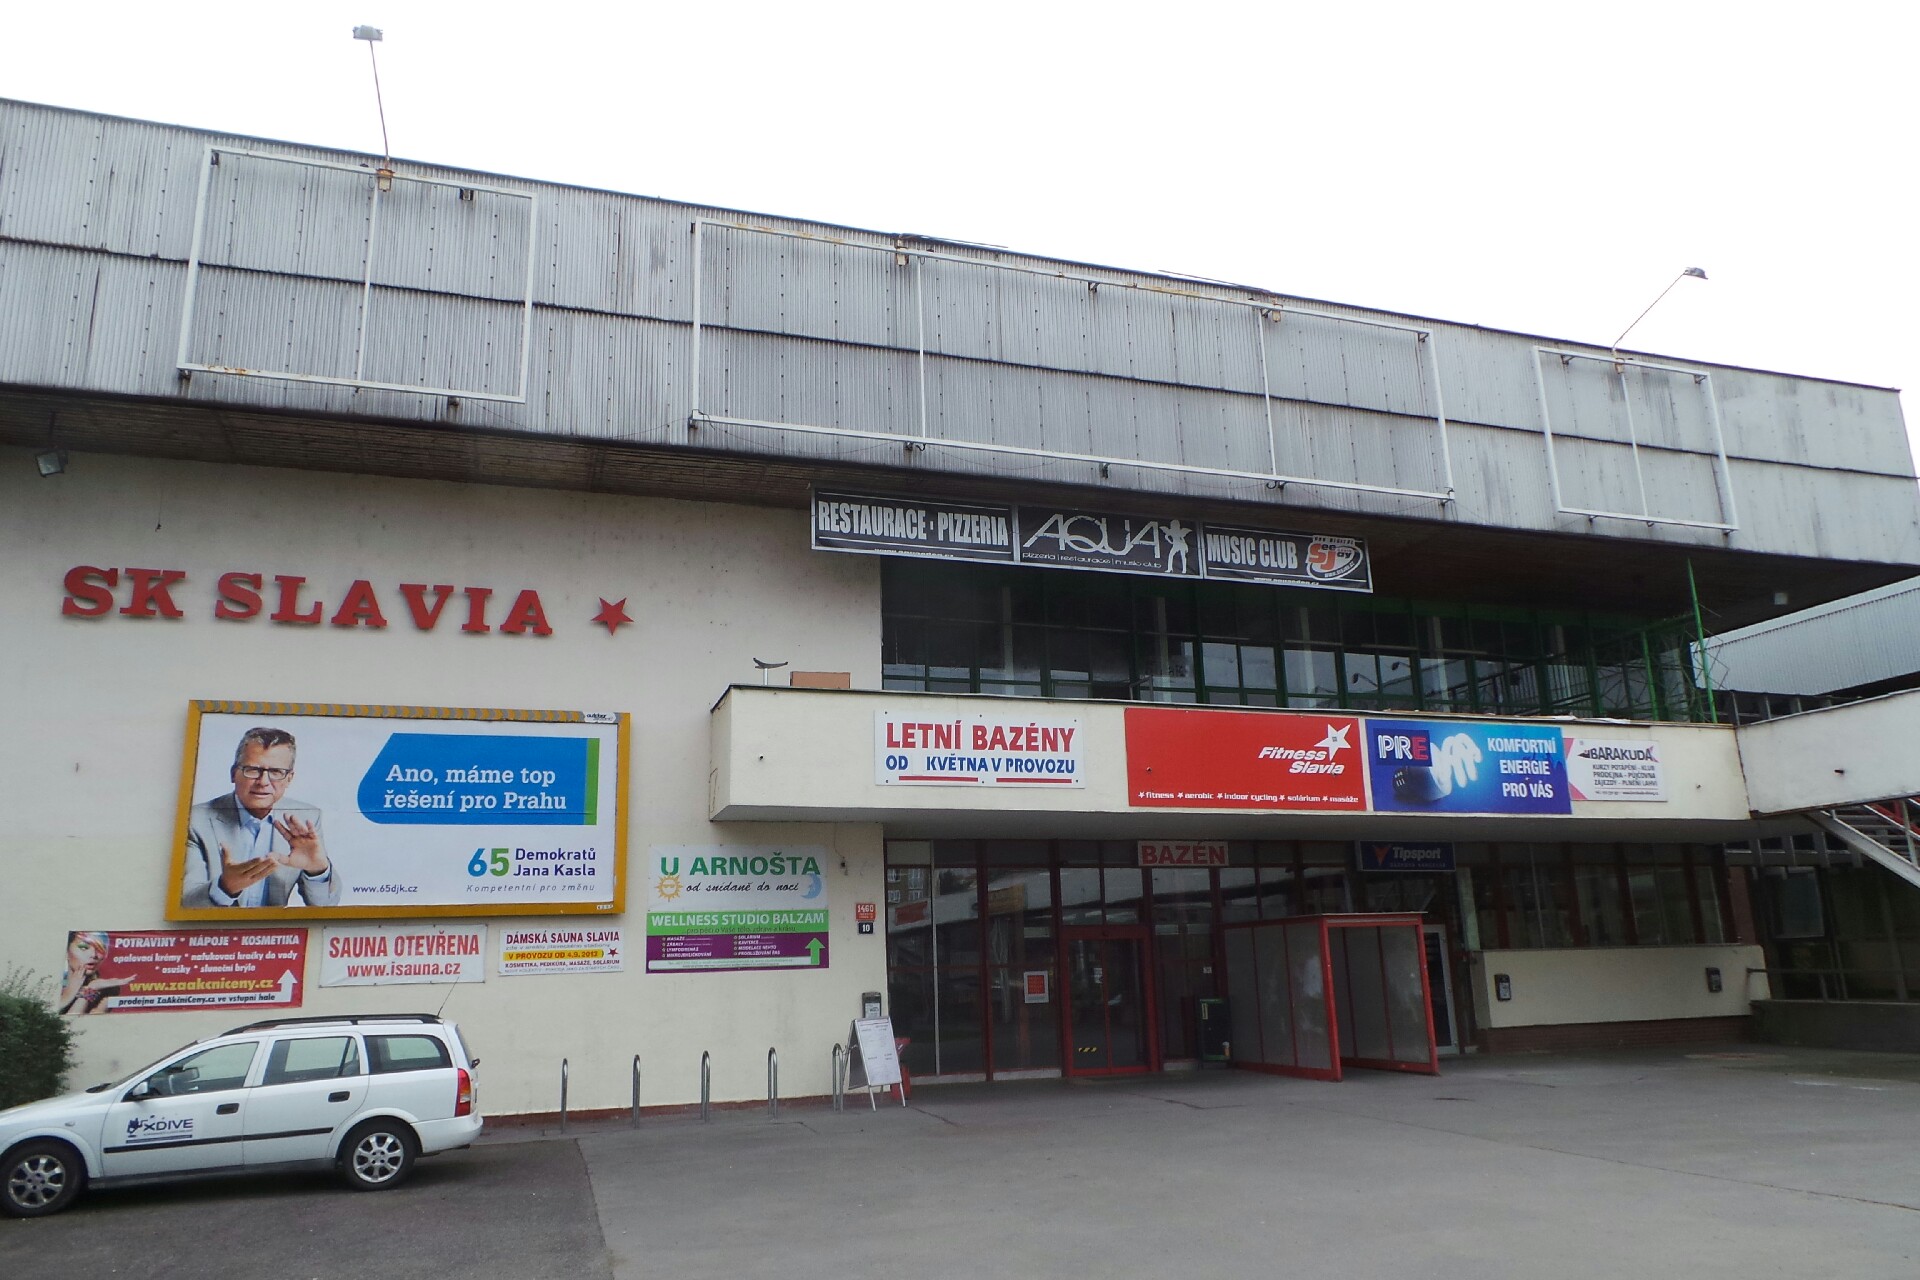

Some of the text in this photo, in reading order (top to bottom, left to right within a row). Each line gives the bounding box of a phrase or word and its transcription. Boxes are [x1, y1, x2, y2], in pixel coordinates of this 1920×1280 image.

[817, 500, 1009, 546] RESTAURACE PIZZERIA
[1022, 513, 1161, 559] AQUA
[1022, 552, 1056, 560] pizzeria
[1060, 555, 1111, 565] restaurace
[1206, 533, 1257, 567] MUSIC
[1259, 538, 1298, 570] CLUB
[61, 565, 553, 636] SK SLAVIA
[886, 719, 1076, 753] LETNÍ BAZÉNY
[1377, 734, 1430, 761] PRE
[1487, 735, 1557, 754] KOMFORTNÍ
[1257, 746, 1328, 762] Fitness
[1590, 746, 1653, 761] BARAKUDA
[885, 752, 1075, 774] OD KVĚTNA V PROVOZU
[1288, 760, 1345, 776] Slavia
[1499, 759, 1551, 775] ENERGIE
[385, 764, 556, 788] Ano, máme top
[1593, 771, 1623, 779] PRODEJNA
[1145, 790, 1175, 800] fitness
[1184, 791, 1215, 801] aerobic
[1224, 792, 1249, 801] indoor
[1250, 792, 1279, 804] cycling
[1287, 793, 1321, 803] solárium
[1502, 780, 1554, 799] PRO VÁS
[383, 789, 567, 813] řešení pro Prahu
[515, 847, 597, 862] Demokratů
[1141, 840, 1227, 866] BAZÉN
[1391, 846, 1442, 861] Tipsport
[467, 847, 510, 878] 65
[660, 851, 821, 876] U ARNOŠTA
[512, 864, 596, 878] Jana Kasla
[352, 883, 419, 894] www.65djk.cz
[466, 883, 596, 893] Kompetentní pro změnu
[686, 880, 800, 892] od snídaně do noci
[857, 904, 874, 913] 1460
[651, 911, 824, 927] WELLNESS STUDIO BALZAM
[862, 924, 871, 933] 10
[114, 934, 300, 949] POTRAVINY NÁPOJE KOSMETIKA
[328, 929, 480, 959] SAUNA OTEVŘENA
[505, 930, 620, 945] DÁMSKÁ SAUNA SLAVIA
[154, 952, 182, 963] krémy
[265, 951, 277, 960] do
[277, 950, 298, 961] vody
[515, 951, 553, 960] PROVOZU
[554, 951, 566, 959] OD
[346, 960, 462, 978] www.isauna.cz
[129, 976, 274, 992] www.zaakcniceny.cz
[118, 995, 155, 1007] prodejna
[217, 995, 227, 1003] ve
[258, 992, 276, 1002] hale
